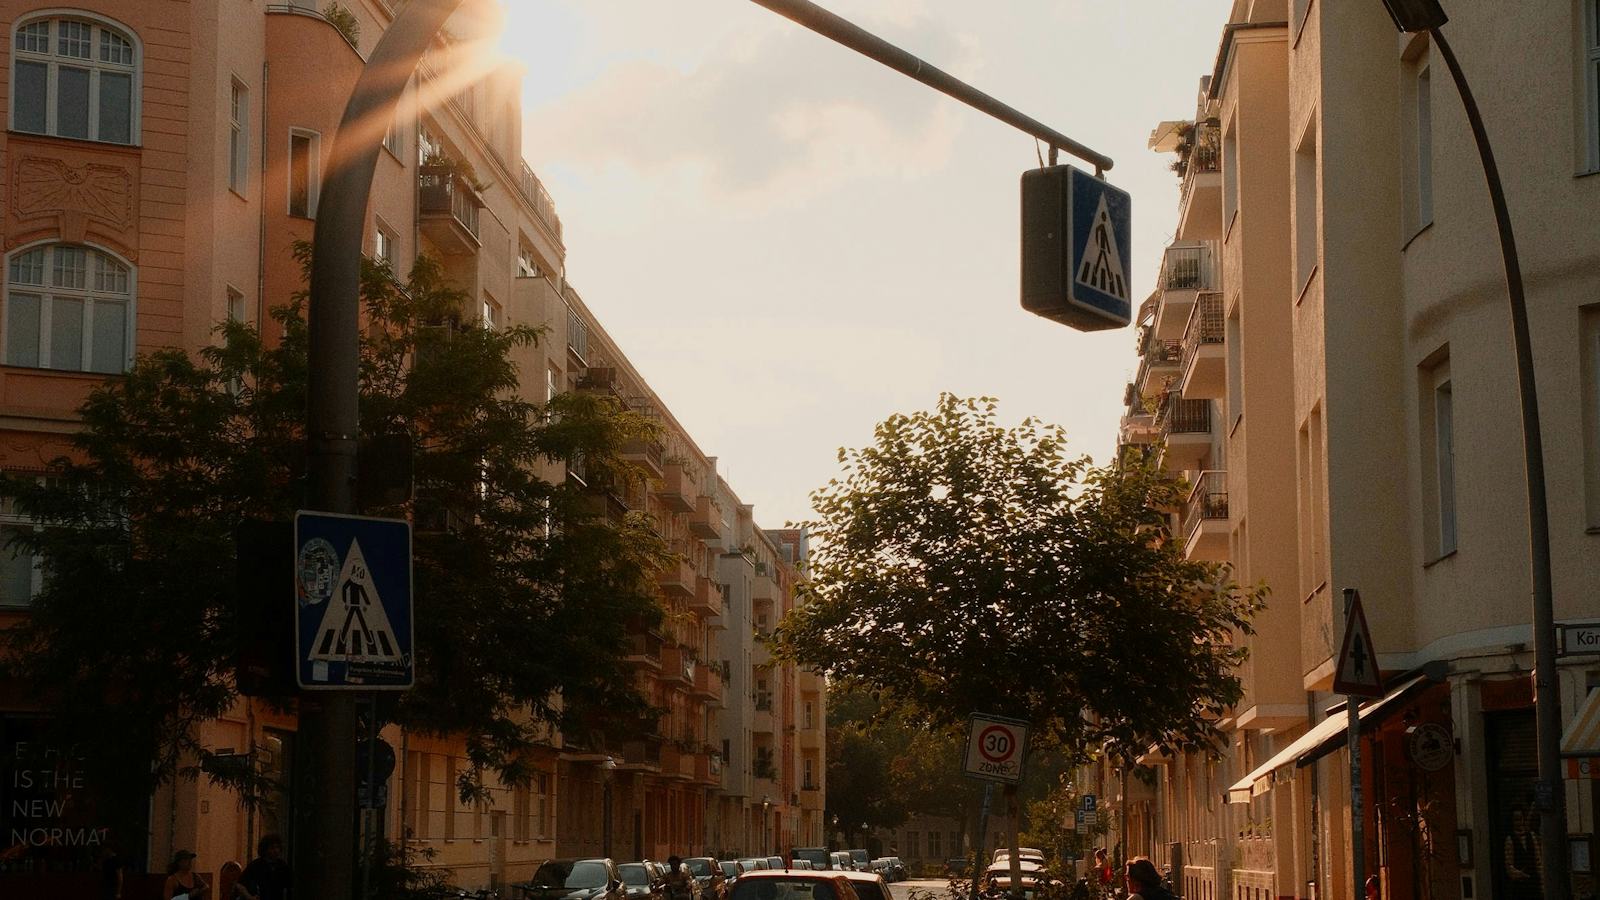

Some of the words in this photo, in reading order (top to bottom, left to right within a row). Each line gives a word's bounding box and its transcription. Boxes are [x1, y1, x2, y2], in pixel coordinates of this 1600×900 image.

[985, 735, 1008, 753] 30
[979, 761, 1009, 775] ZONE
[14, 769, 34, 789] IS
[40, 769, 86, 789] THE
[12, 799, 66, 818] NEW
